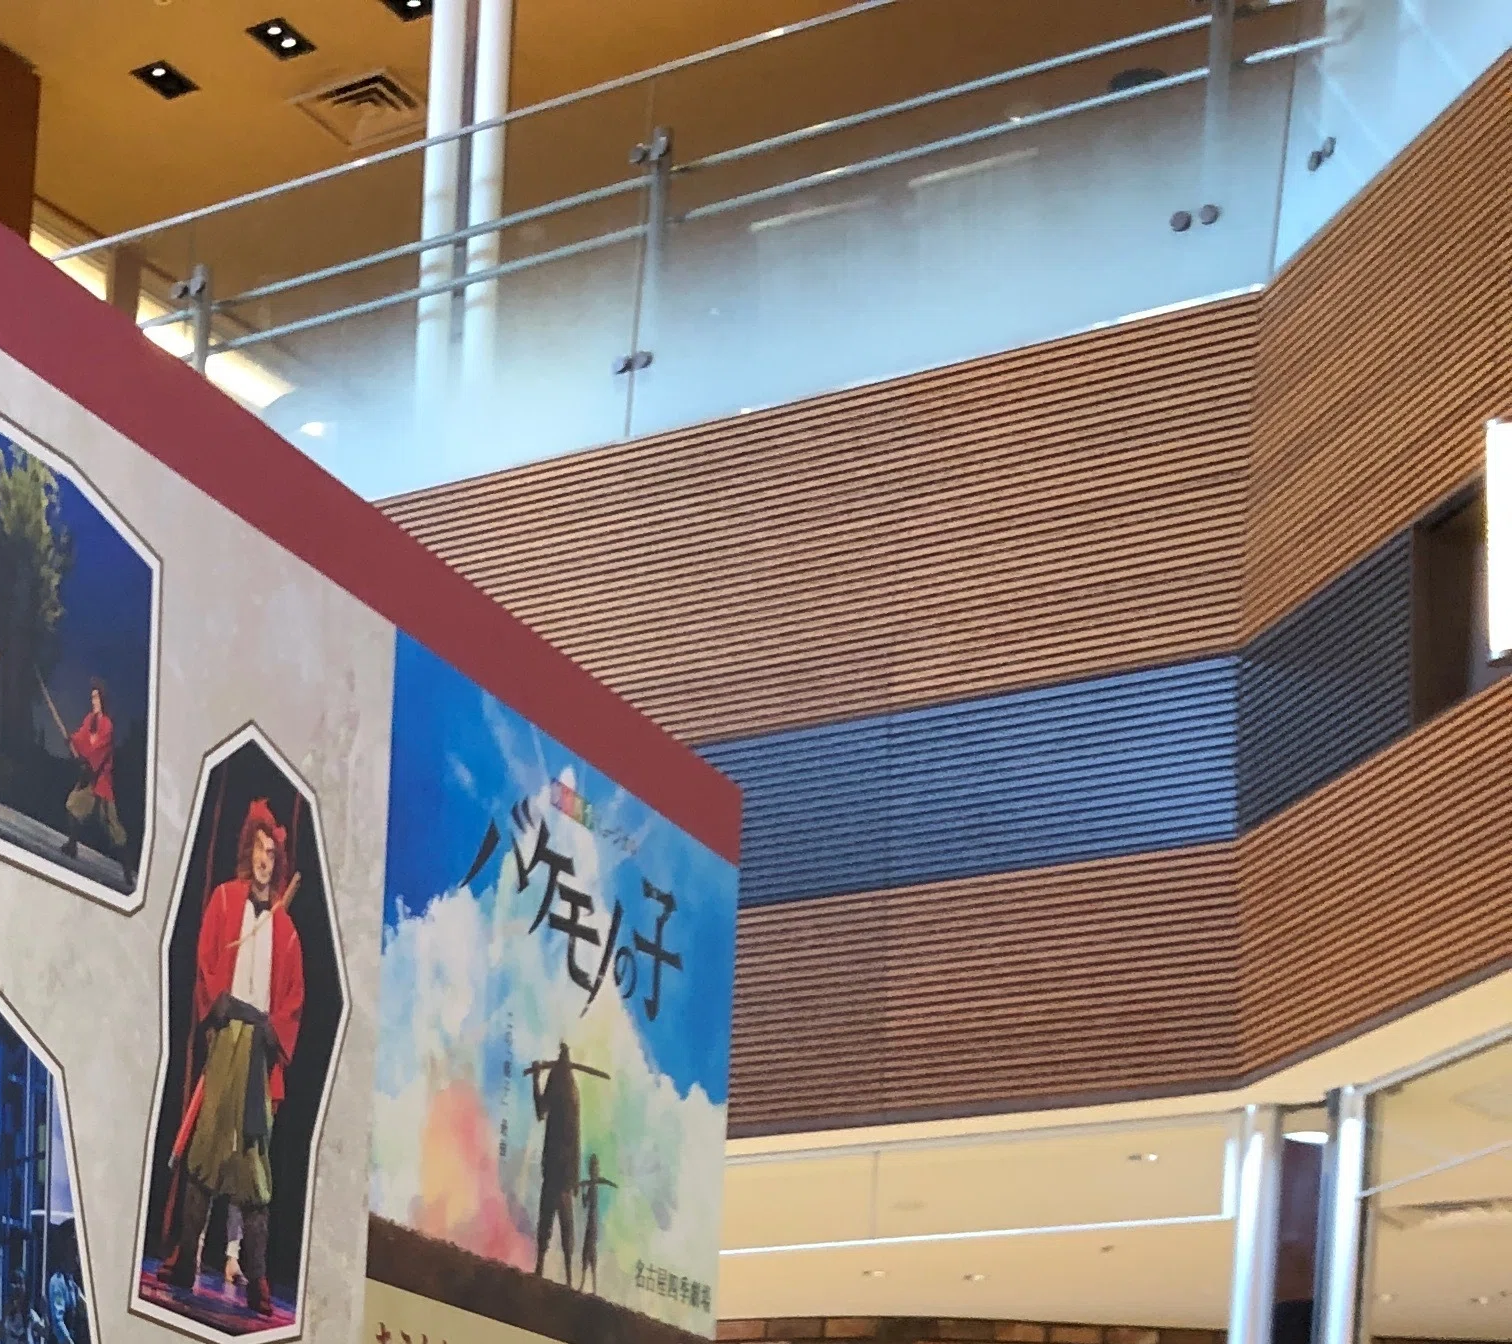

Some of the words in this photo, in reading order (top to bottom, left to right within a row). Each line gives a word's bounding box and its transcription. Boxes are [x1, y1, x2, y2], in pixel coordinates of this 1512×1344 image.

[459, 795, 684, 1021] バケモノの子
